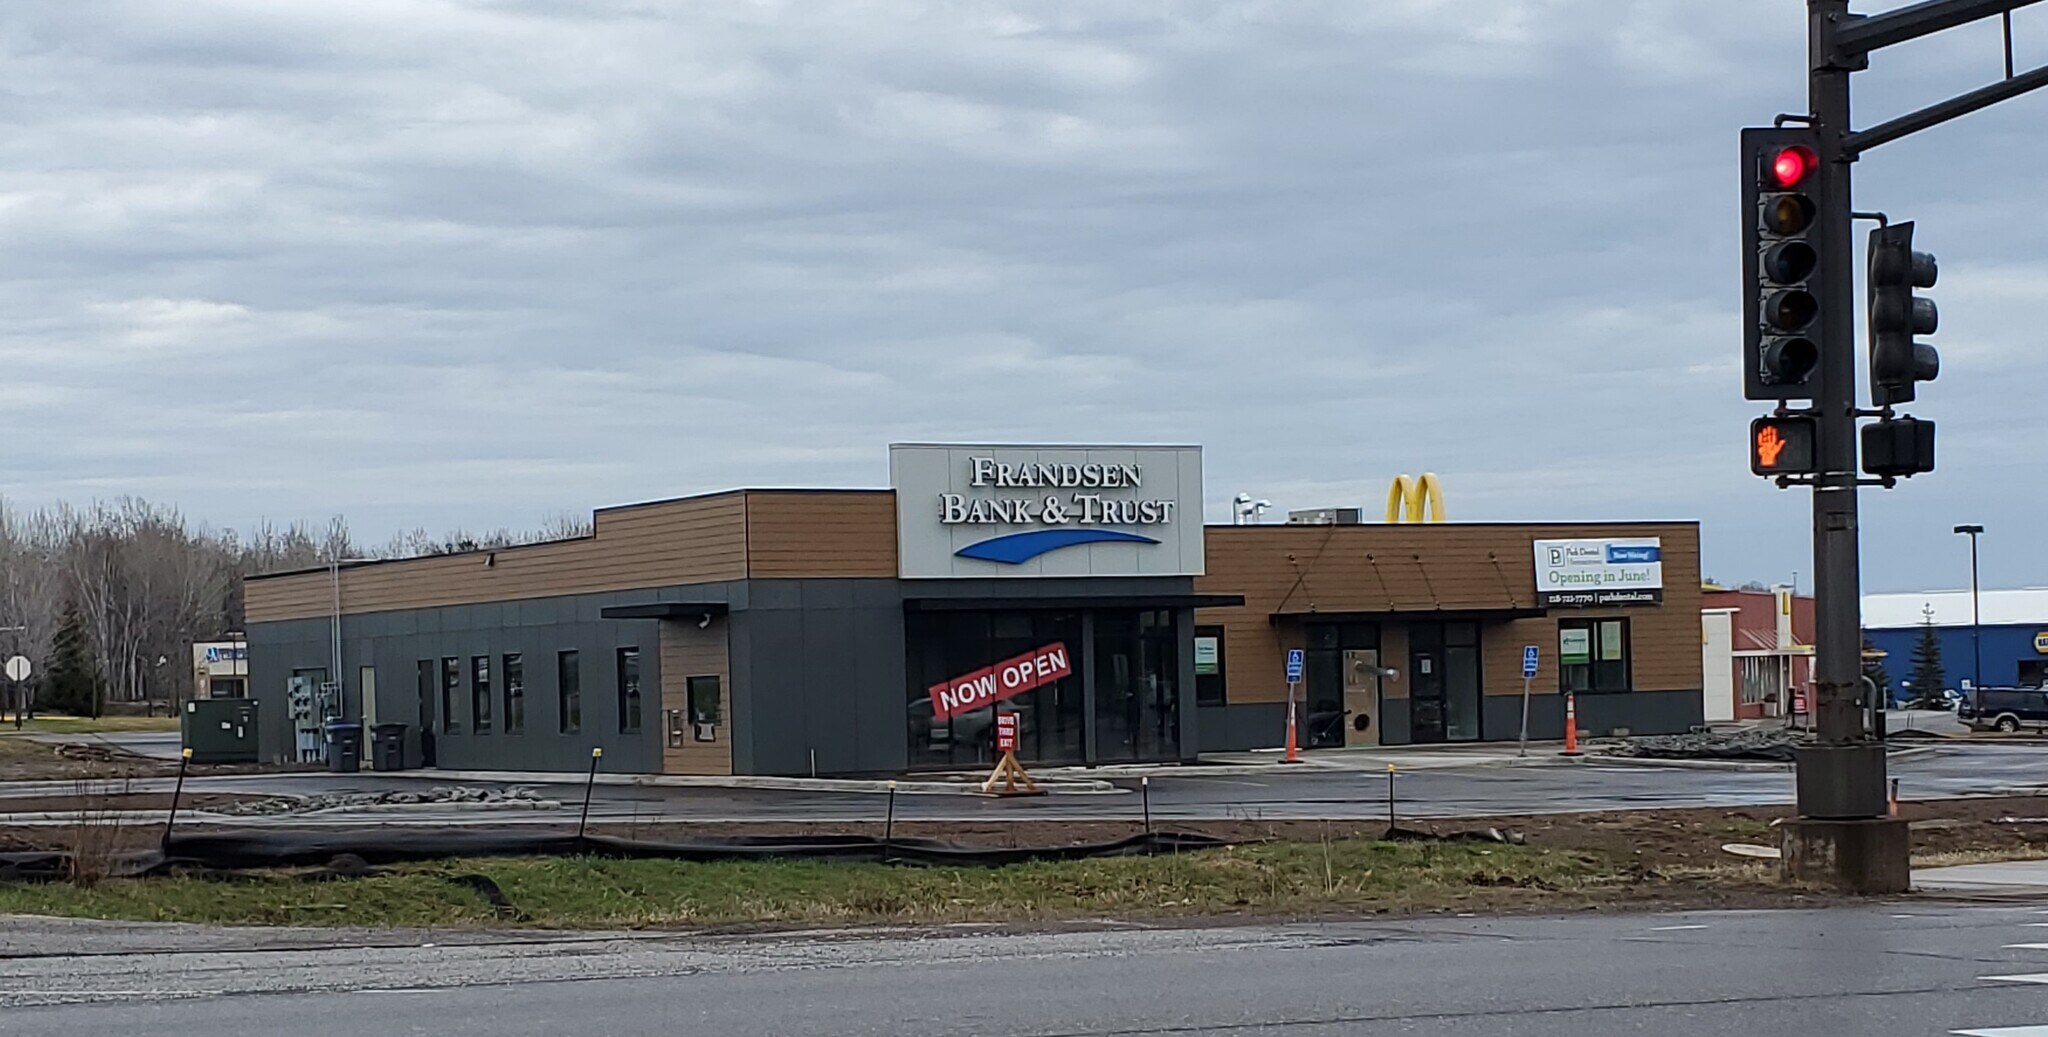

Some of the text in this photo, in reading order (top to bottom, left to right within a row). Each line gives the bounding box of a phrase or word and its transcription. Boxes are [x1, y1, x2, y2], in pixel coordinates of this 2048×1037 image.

[970, 456, 1143, 488] FRANDSEN
[940, 492, 1175, 525] BANK & TRUST
[1548, 568, 1651, 587] Opening in June!
[1599, 592, 1653, 603] parkdental.com
[940, 649, 1067, 712] NOW OPEN
